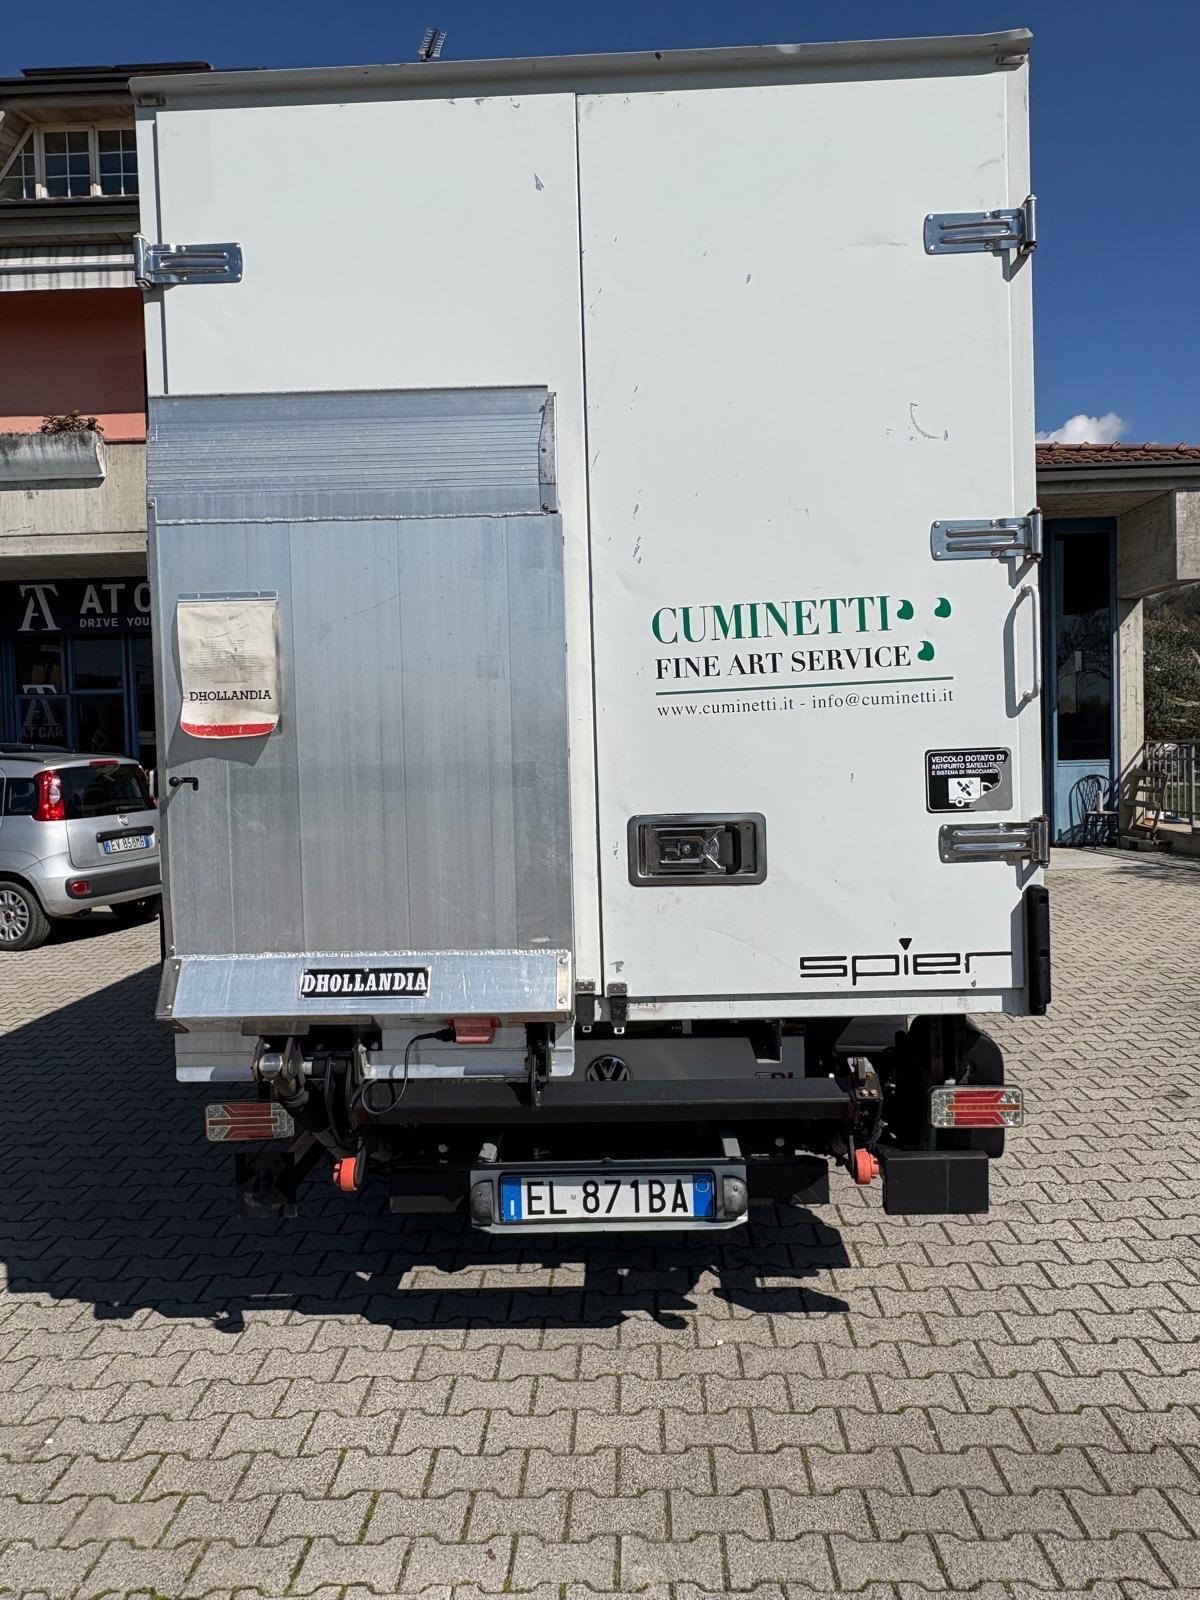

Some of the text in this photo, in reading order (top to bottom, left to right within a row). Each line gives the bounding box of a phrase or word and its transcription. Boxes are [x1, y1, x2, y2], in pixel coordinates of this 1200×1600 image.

[79, 618, 119, 628] DRIVE
[651, 595, 891, 644] CUMINETTI
[655, 645, 912, 680] FINE ART SERVICE
[189, 689, 273, 702] DHOLLANDIA
[656, 698, 795, 717] www.cuminetti.it
[811, 688, 954, 710] info@cuminetti.it
[38, 726, 63, 738] CAR
[931, 753, 1005, 763] VEICOLO DOTATO DI
[800, 937, 1013, 986] spier
[301, 972, 427, 993] DHOLLANDIA
[527, 1180, 568, 1216] EL
[582, 1178, 689, 1214] 871BA
